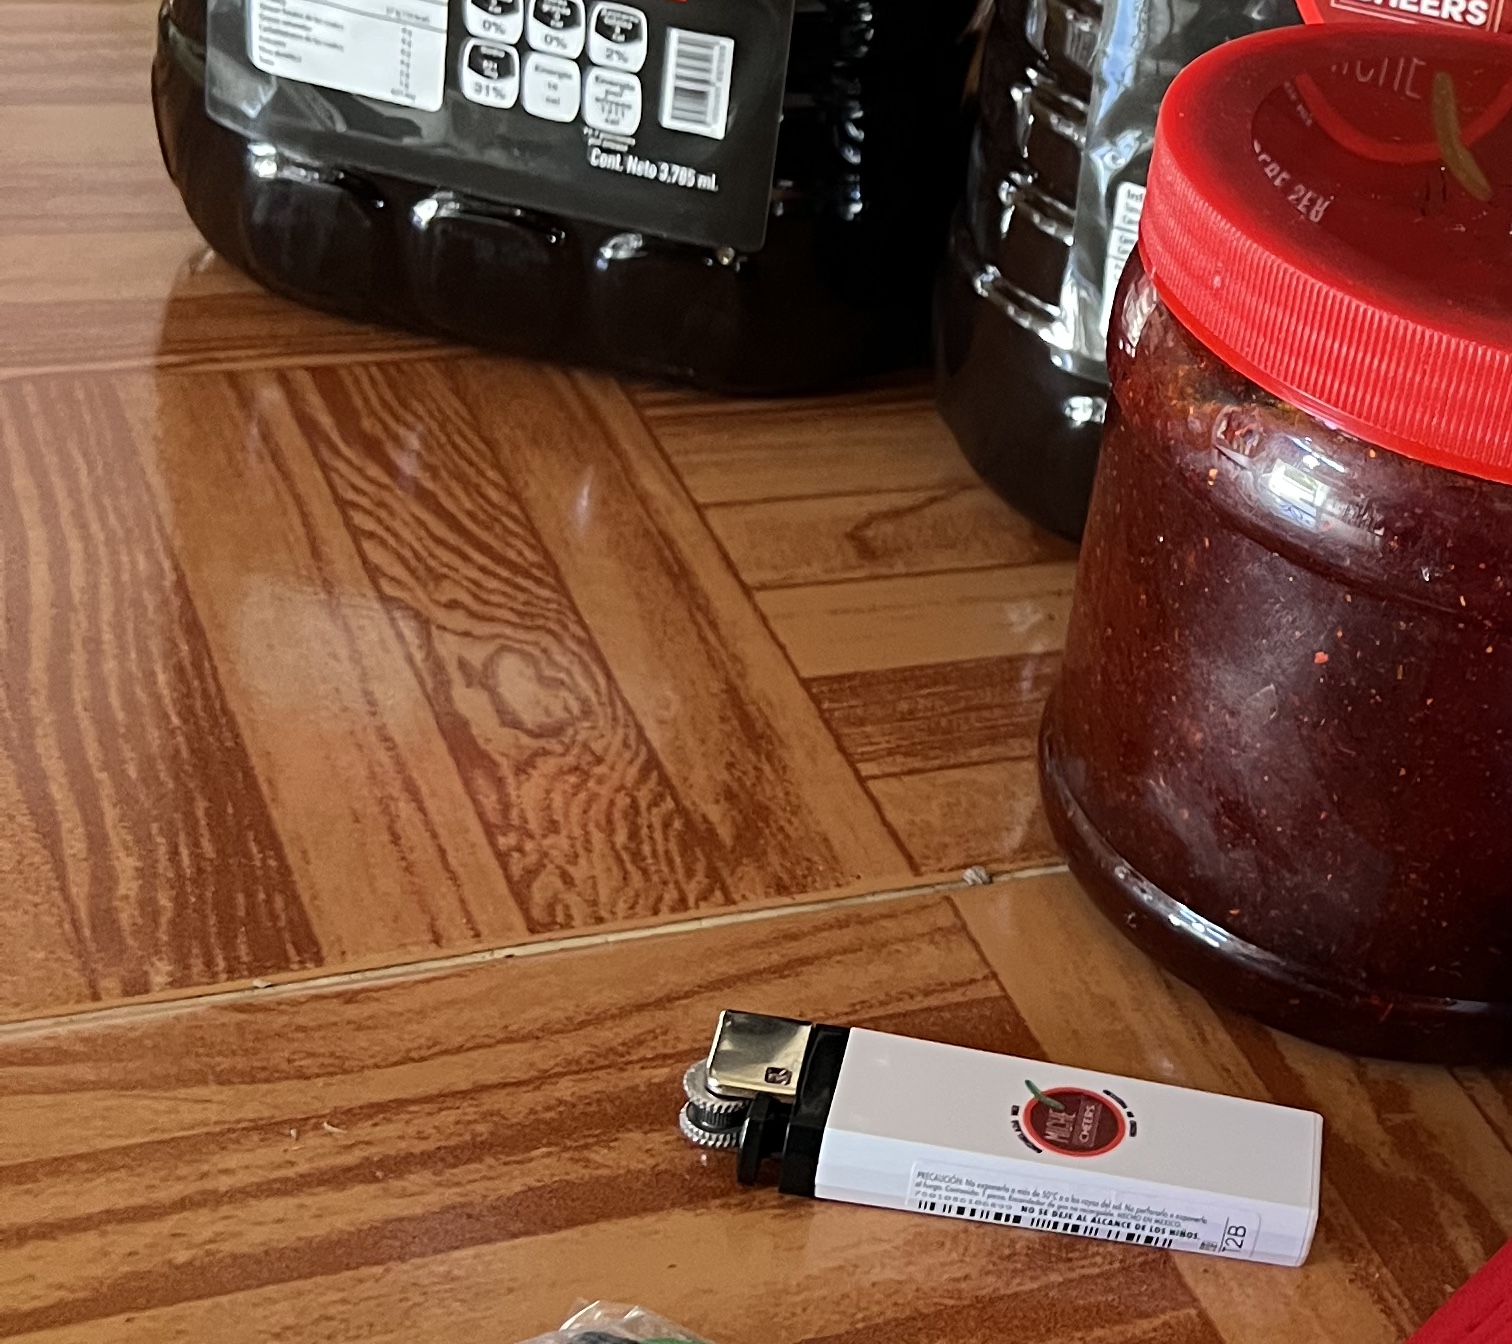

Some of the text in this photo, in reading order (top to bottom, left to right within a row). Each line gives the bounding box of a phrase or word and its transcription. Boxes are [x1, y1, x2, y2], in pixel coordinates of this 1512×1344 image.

[626, 155, 657, 179] Neto
[1079, 1104, 1096, 1143] CHEERS
[1021, 1205, 1035, 1214] NO
[1039, 1208, 1048, 1216] SE
[1052, 1210, 1073, 1220] DEJE
[1076, 1214, 1087, 1222] AL
[1091, 1216, 1131, 1229] ALCANCE
[1135, 1223, 1146, 1231] DE
[1149, 1226, 1166, 1235] LOS
